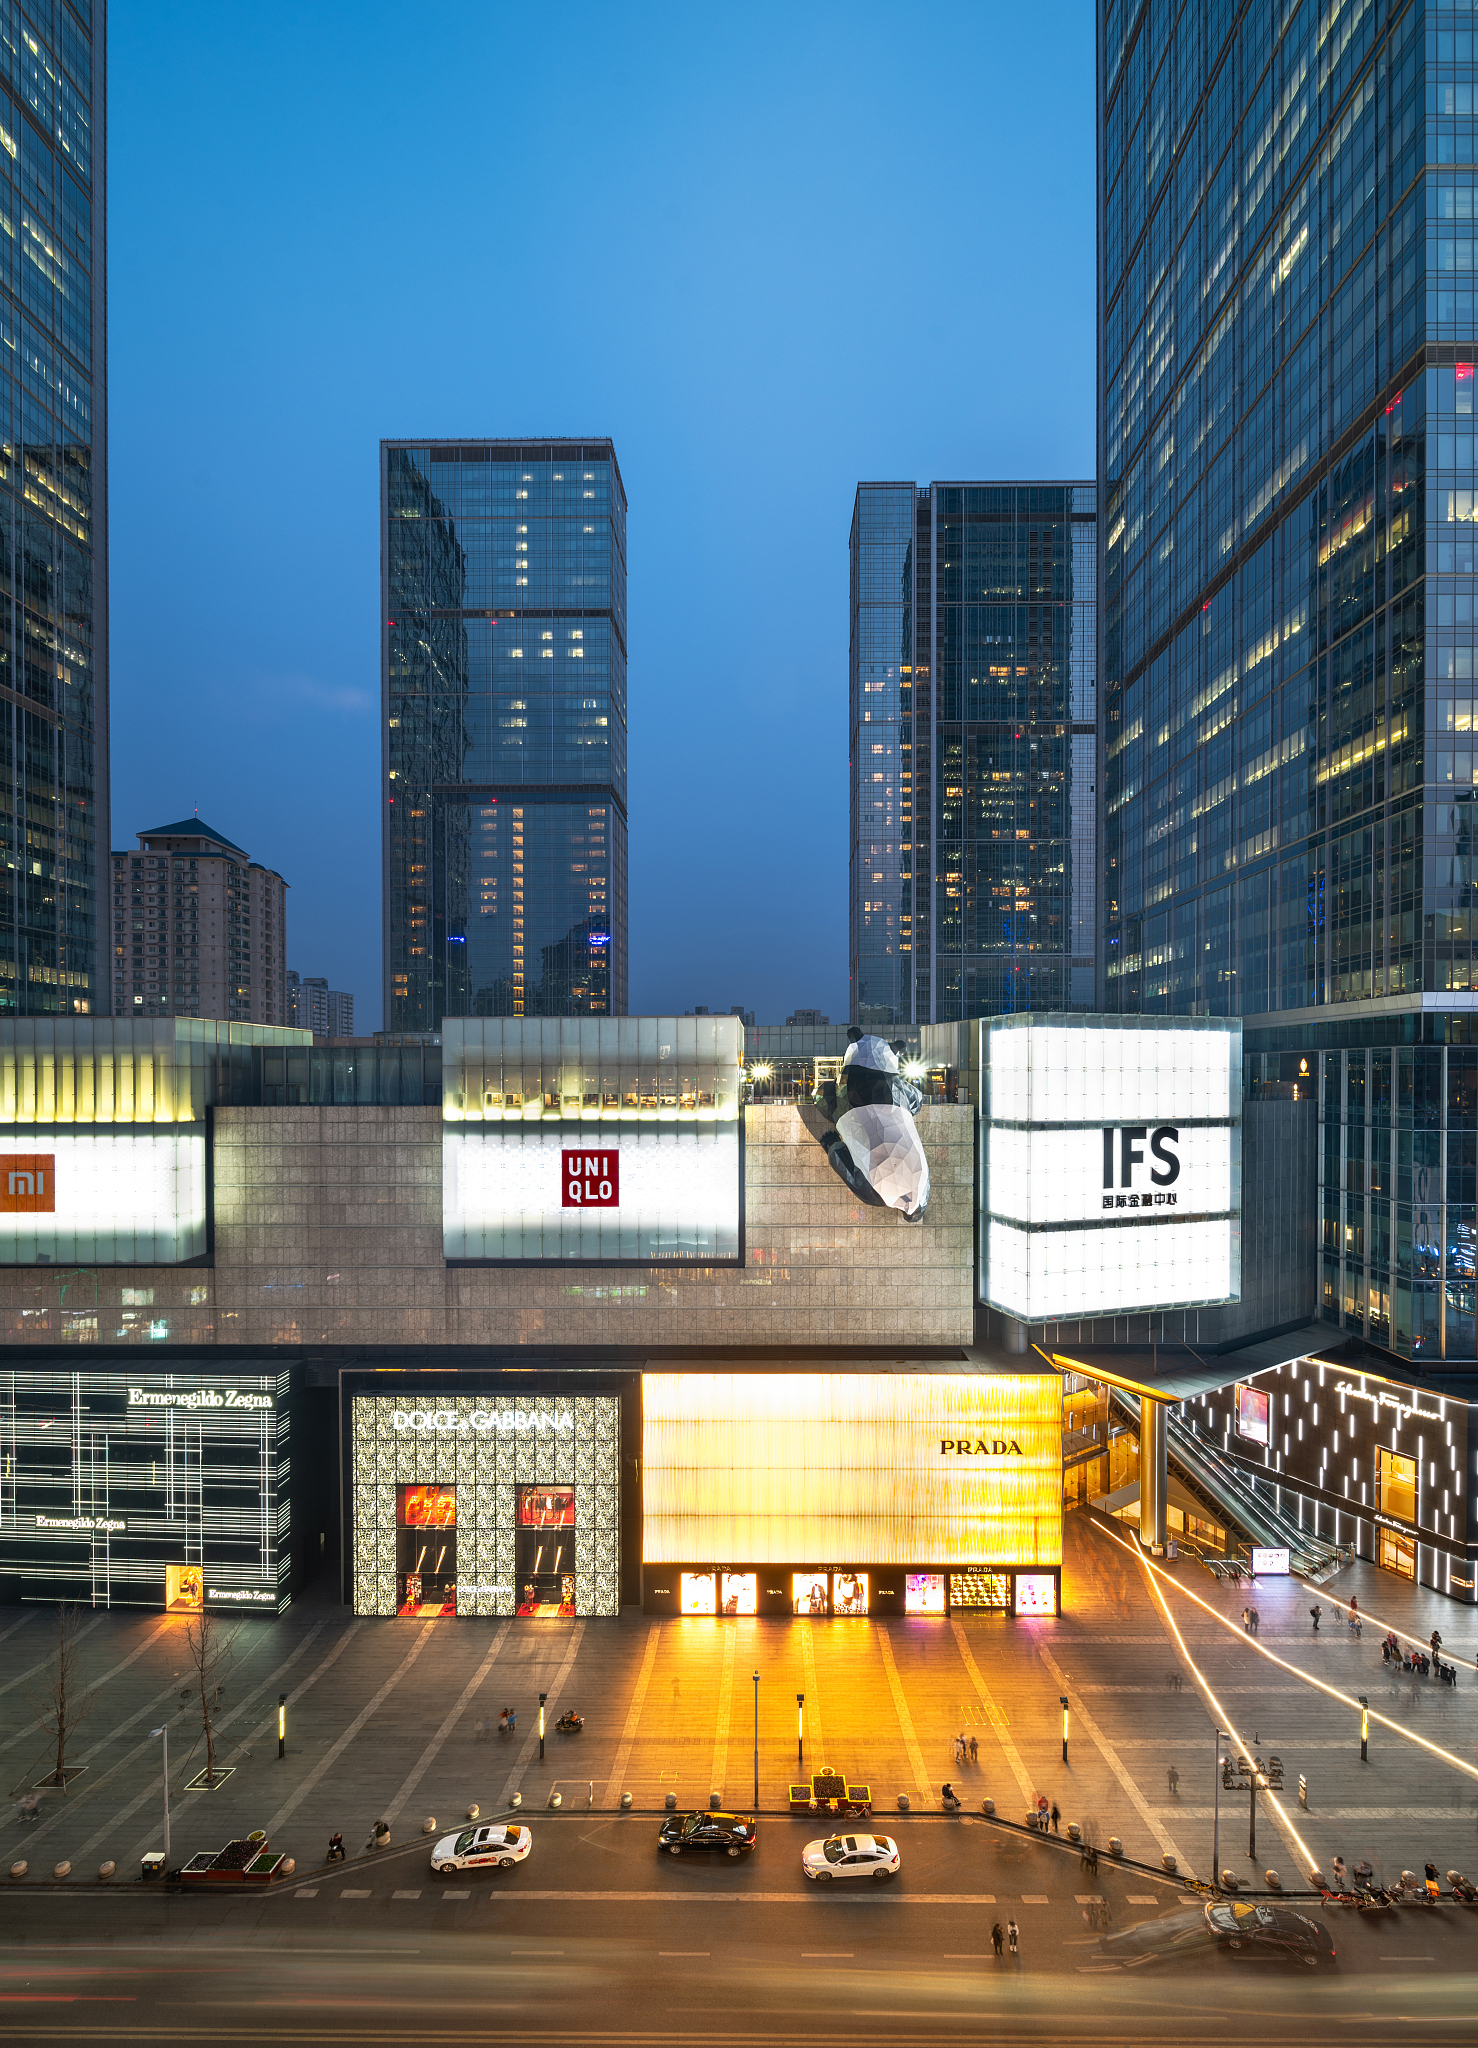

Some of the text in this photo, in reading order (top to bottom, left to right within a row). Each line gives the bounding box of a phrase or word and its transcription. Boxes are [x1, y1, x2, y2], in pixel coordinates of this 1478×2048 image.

[568, 1157, 608, 1176] UNI
[1103, 1126, 1180, 1189] IFS
[568, 1180, 612, 1203] QLO
[1102, 1192, 1178, 1209] 国际金融中心
[127, 1388, 273, 1411] Ermenegildo Zegna
[940, 1440, 1023, 1455] PRADA
[35, 1515, 126, 1531] Ermenegildo Zegna
[208, 1589, 276, 1602] Ermenegildo Zegna
